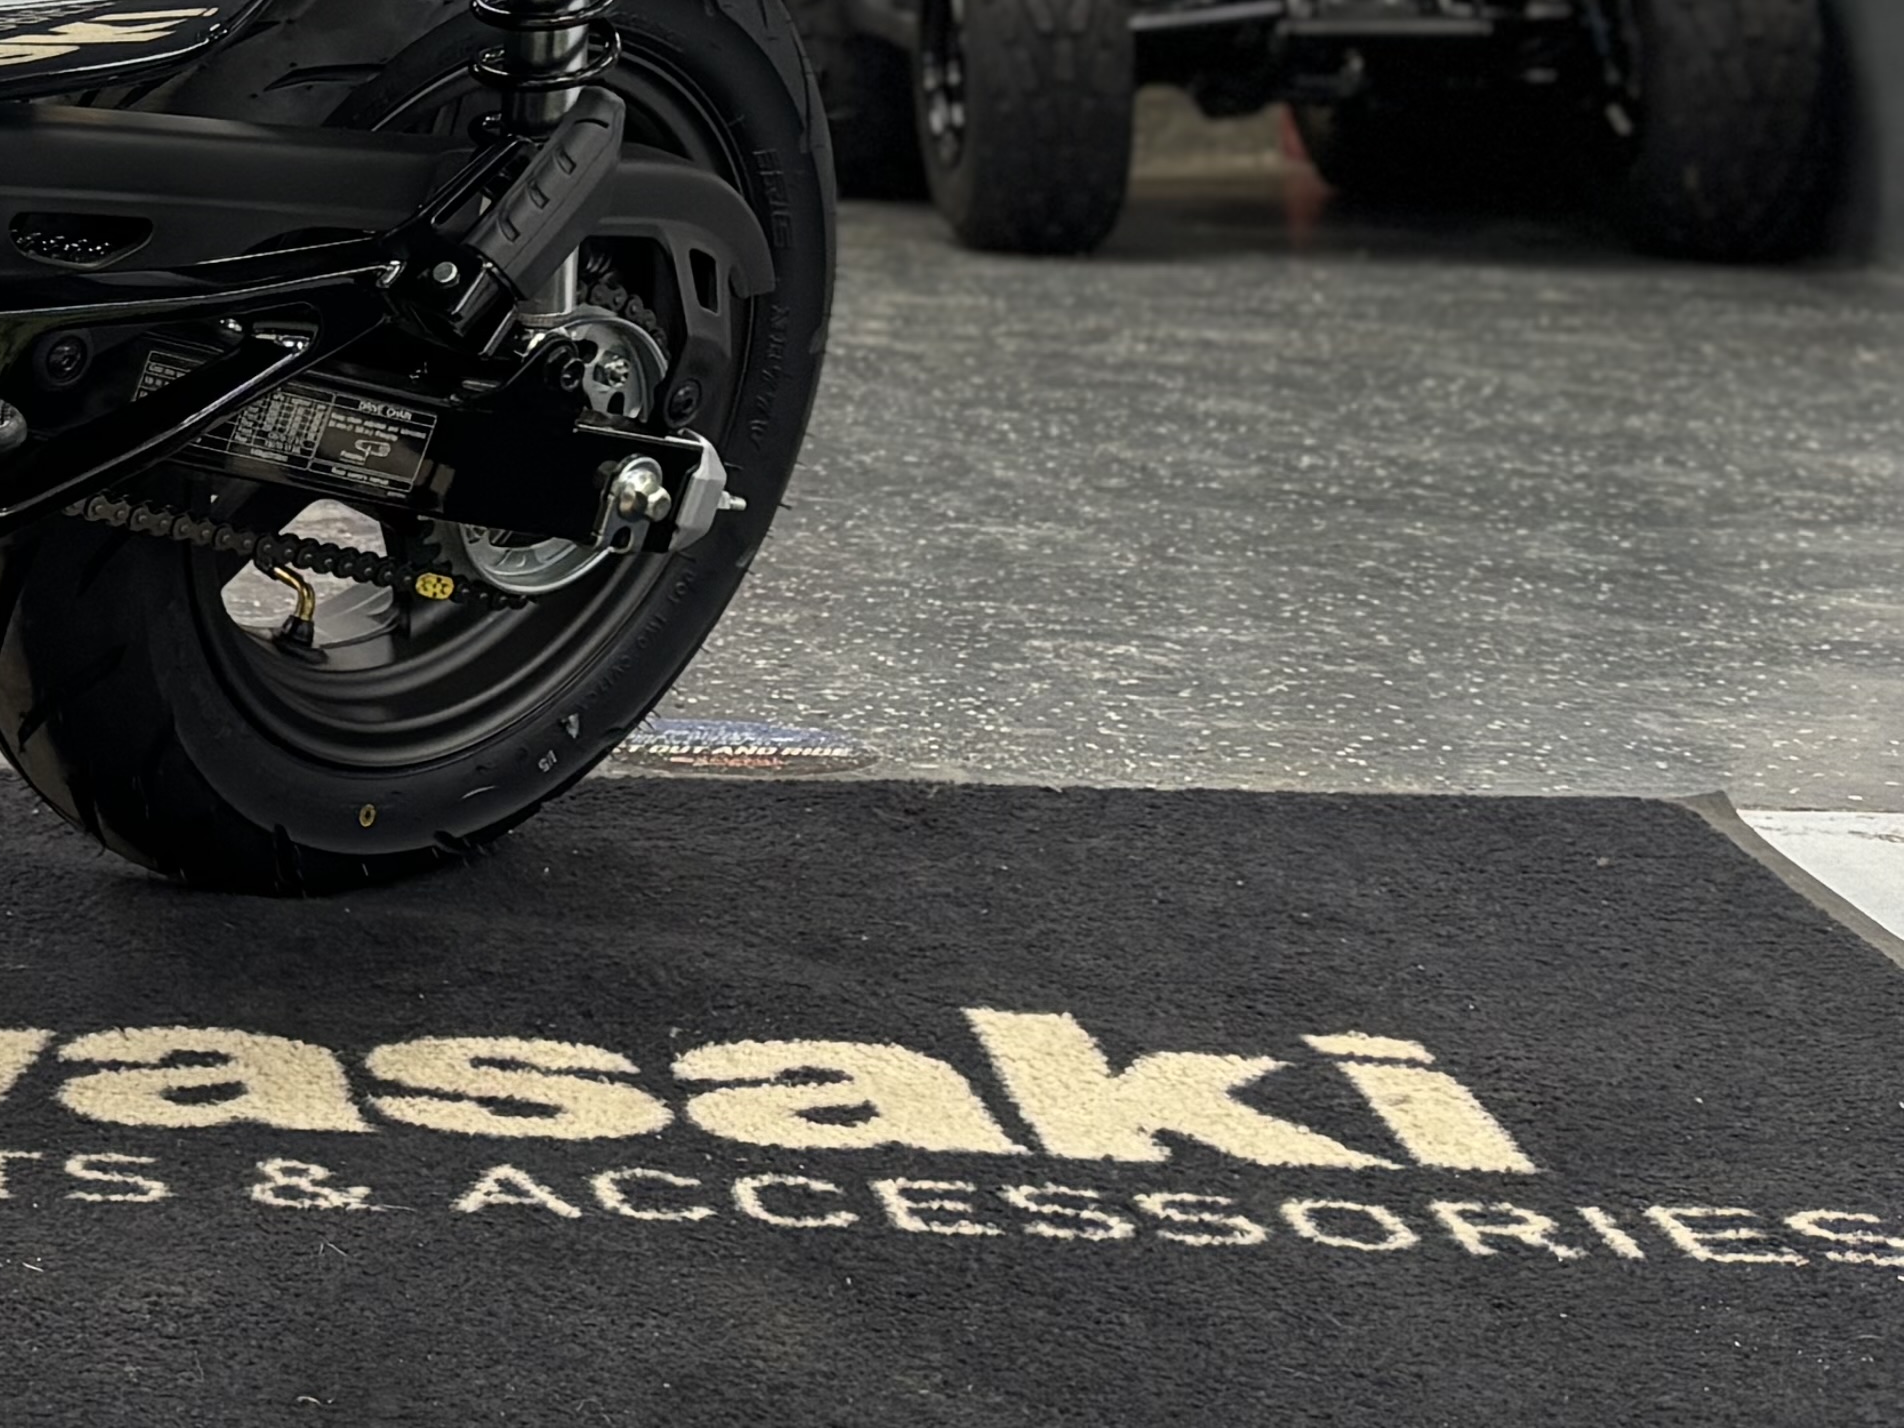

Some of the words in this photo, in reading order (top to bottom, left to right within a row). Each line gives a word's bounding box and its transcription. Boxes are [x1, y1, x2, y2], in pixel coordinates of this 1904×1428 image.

[712, 745, 778, 757] AND
[251, 1158, 377, 1212] &
[453, 1162, 1904, 1267] ACCESSORIES
